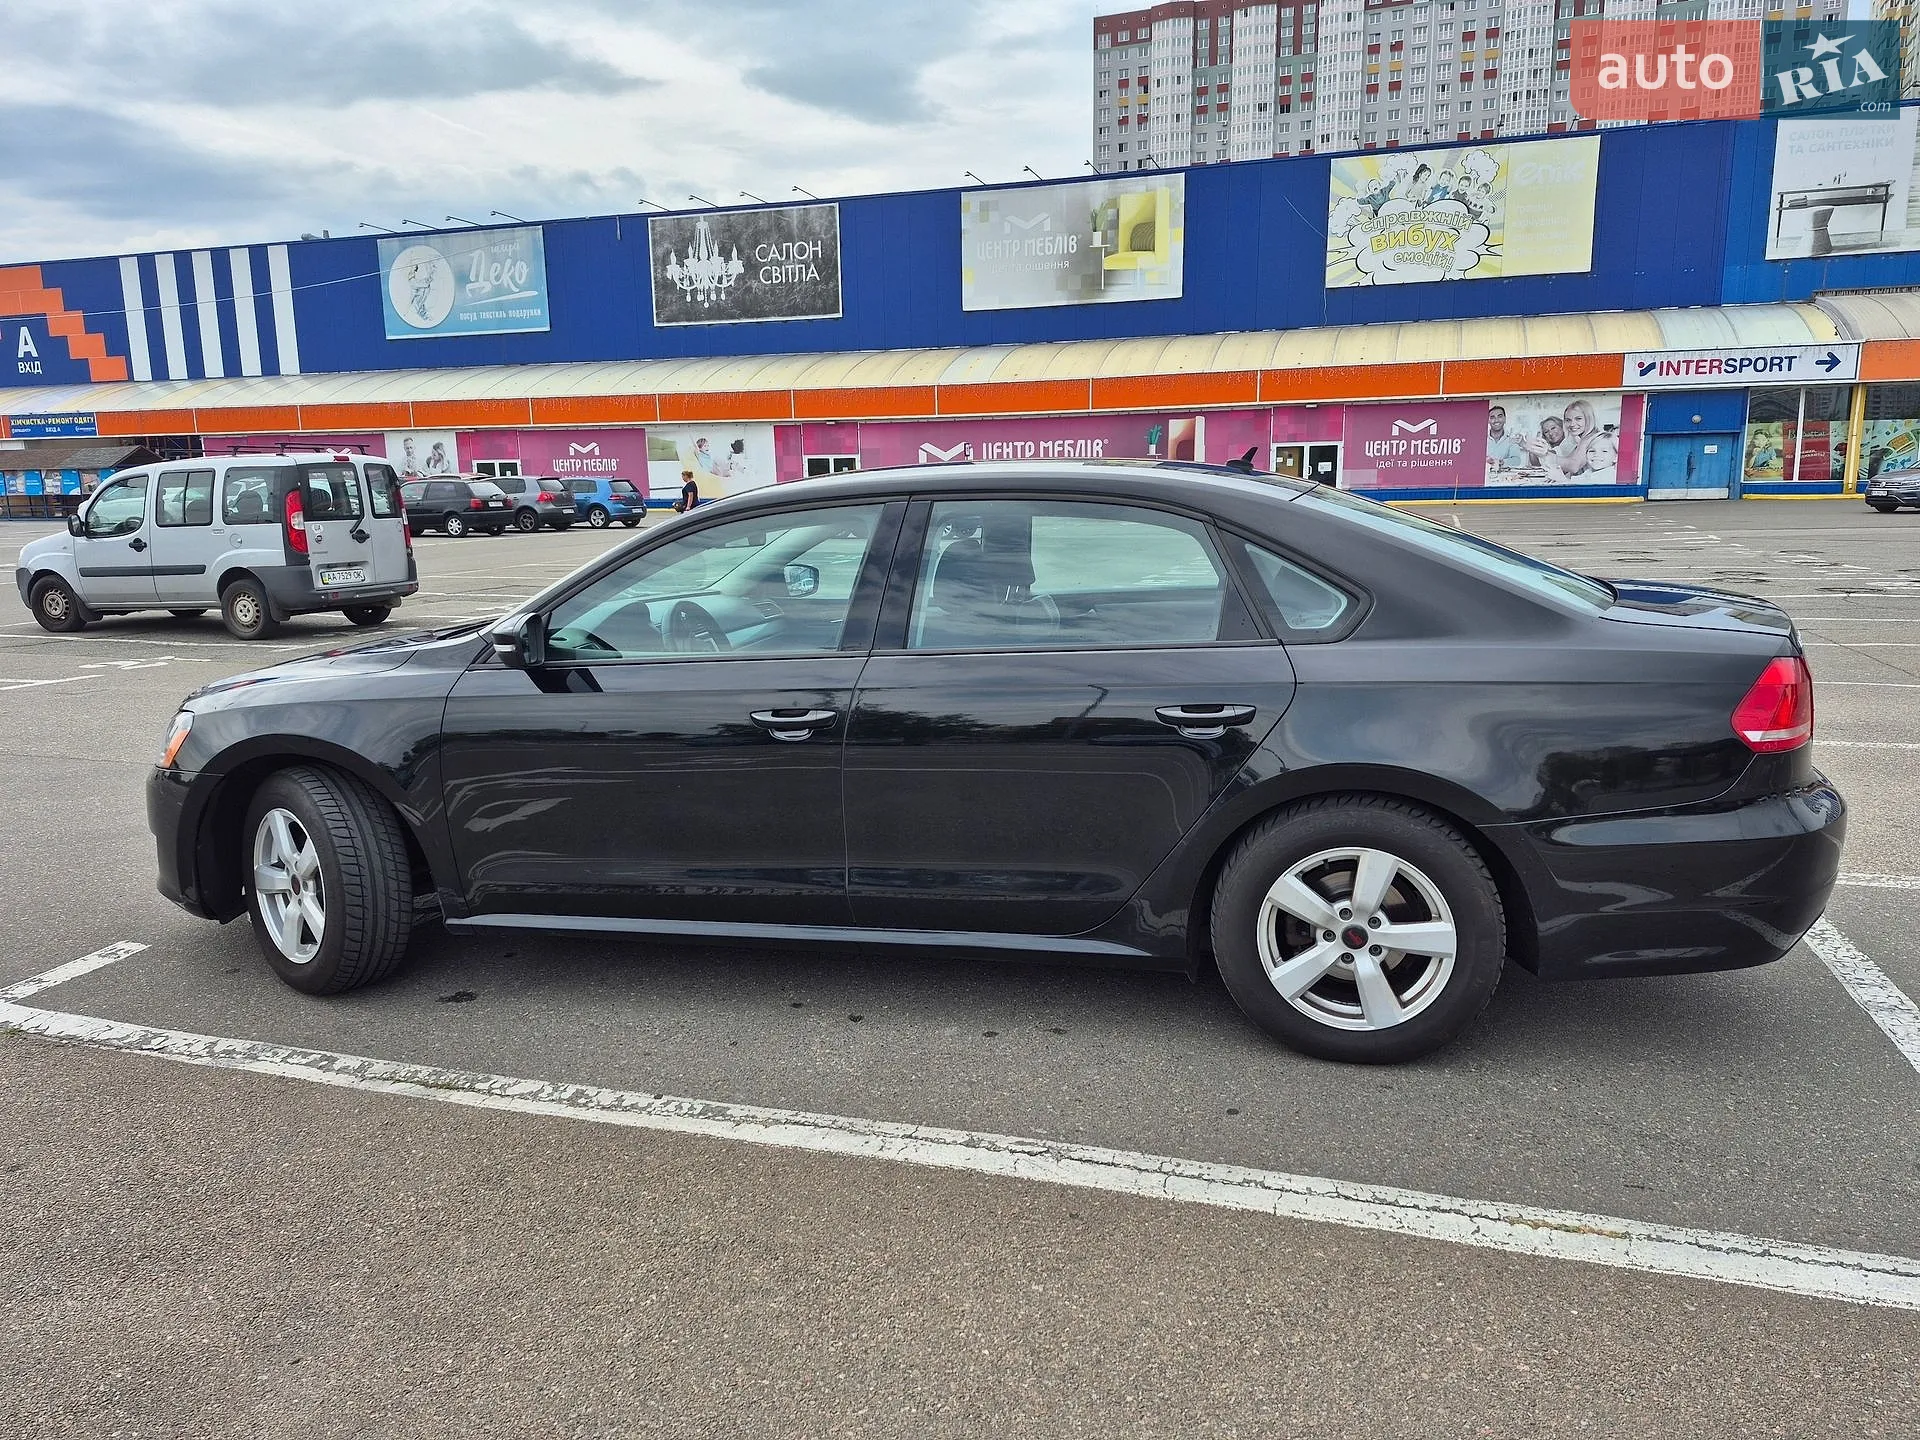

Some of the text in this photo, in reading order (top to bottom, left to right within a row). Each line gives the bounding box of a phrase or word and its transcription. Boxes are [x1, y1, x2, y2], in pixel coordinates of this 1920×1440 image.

[1789, 128, 1834, 142] САЛОН
[1788, 144, 1804, 154] ТА
[1361, 210, 1473, 233] справжній
[1370, 223, 1459, 253] вибух
[755, 240, 822, 262] САЛОН
[977, 240, 1020, 261] ЦЕНТР
[1393, 251, 1455, 272] емоцій!
[466, 250, 528, 297] Деко
[760, 263, 820, 284] СВІТЛА
[460, 312, 477, 322] посуд
[509, 308, 541, 319] подарунки
[18, 326, 38, 358] А
[17, 361, 43, 375] ВХІД
[1658, 355, 1798, 377] INTERSPORT
[982, 441, 1035, 460] ЦЕНТР
[1365, 438, 1461, 458] ЦЕНТР МЕБЛІВ
[553, 458, 617, 472] ЦЕНТР МЕБЛІВ
[1376, 458, 1453, 469] ідеї та рішення
